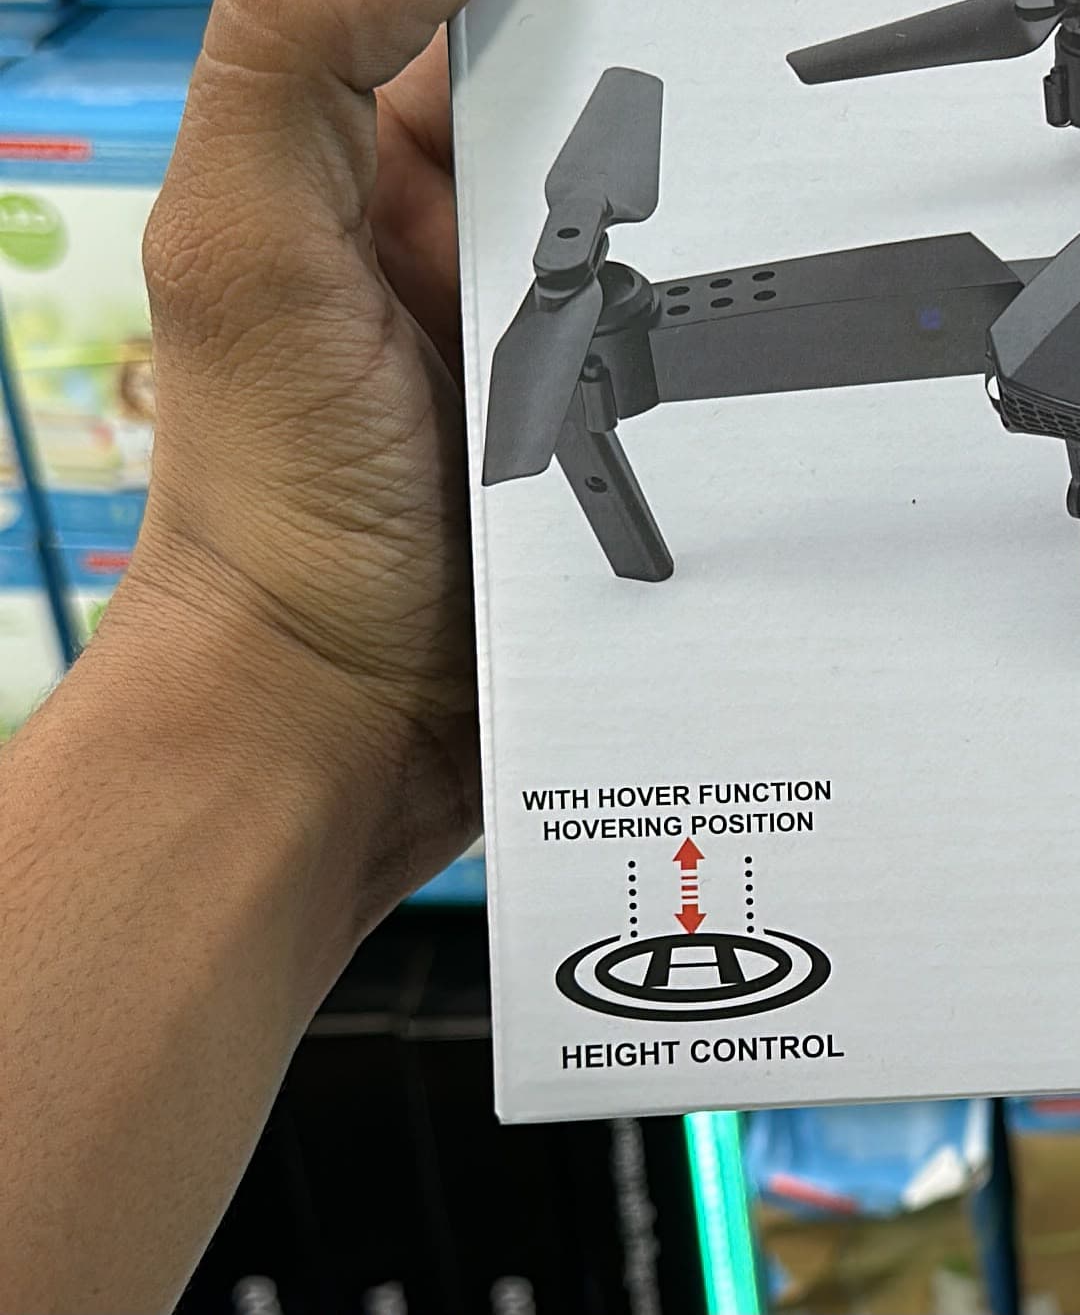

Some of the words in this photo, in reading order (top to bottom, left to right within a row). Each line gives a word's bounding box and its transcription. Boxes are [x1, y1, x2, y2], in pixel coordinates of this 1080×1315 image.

[522, 788, 589, 810] WITH
[598, 785, 691, 808] HOVER
[699, 780, 831, 805] FUNCTION
[543, 816, 682, 840] HOVERING
[691, 811, 814, 835] POSITION
[561, 1041, 681, 1069] HEIGHT
[690, 1034, 845, 1064] CONTROL
